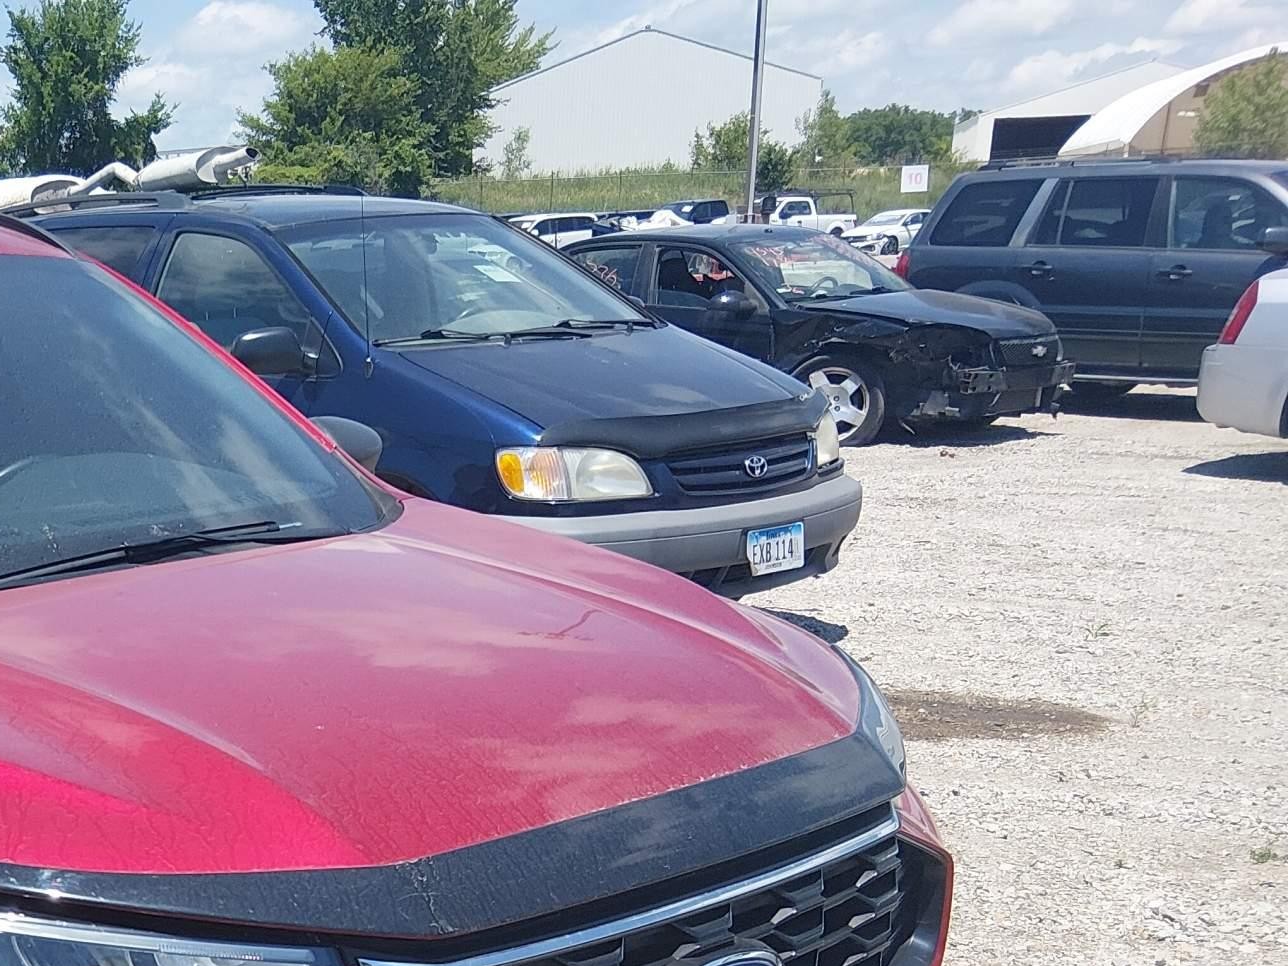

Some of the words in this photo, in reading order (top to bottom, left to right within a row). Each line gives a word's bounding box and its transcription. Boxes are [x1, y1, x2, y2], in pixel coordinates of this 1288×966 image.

[908, 172, 922, 185] 10
[753, 542, 772, 565] EXB
[775, 538, 794, 561] 114
